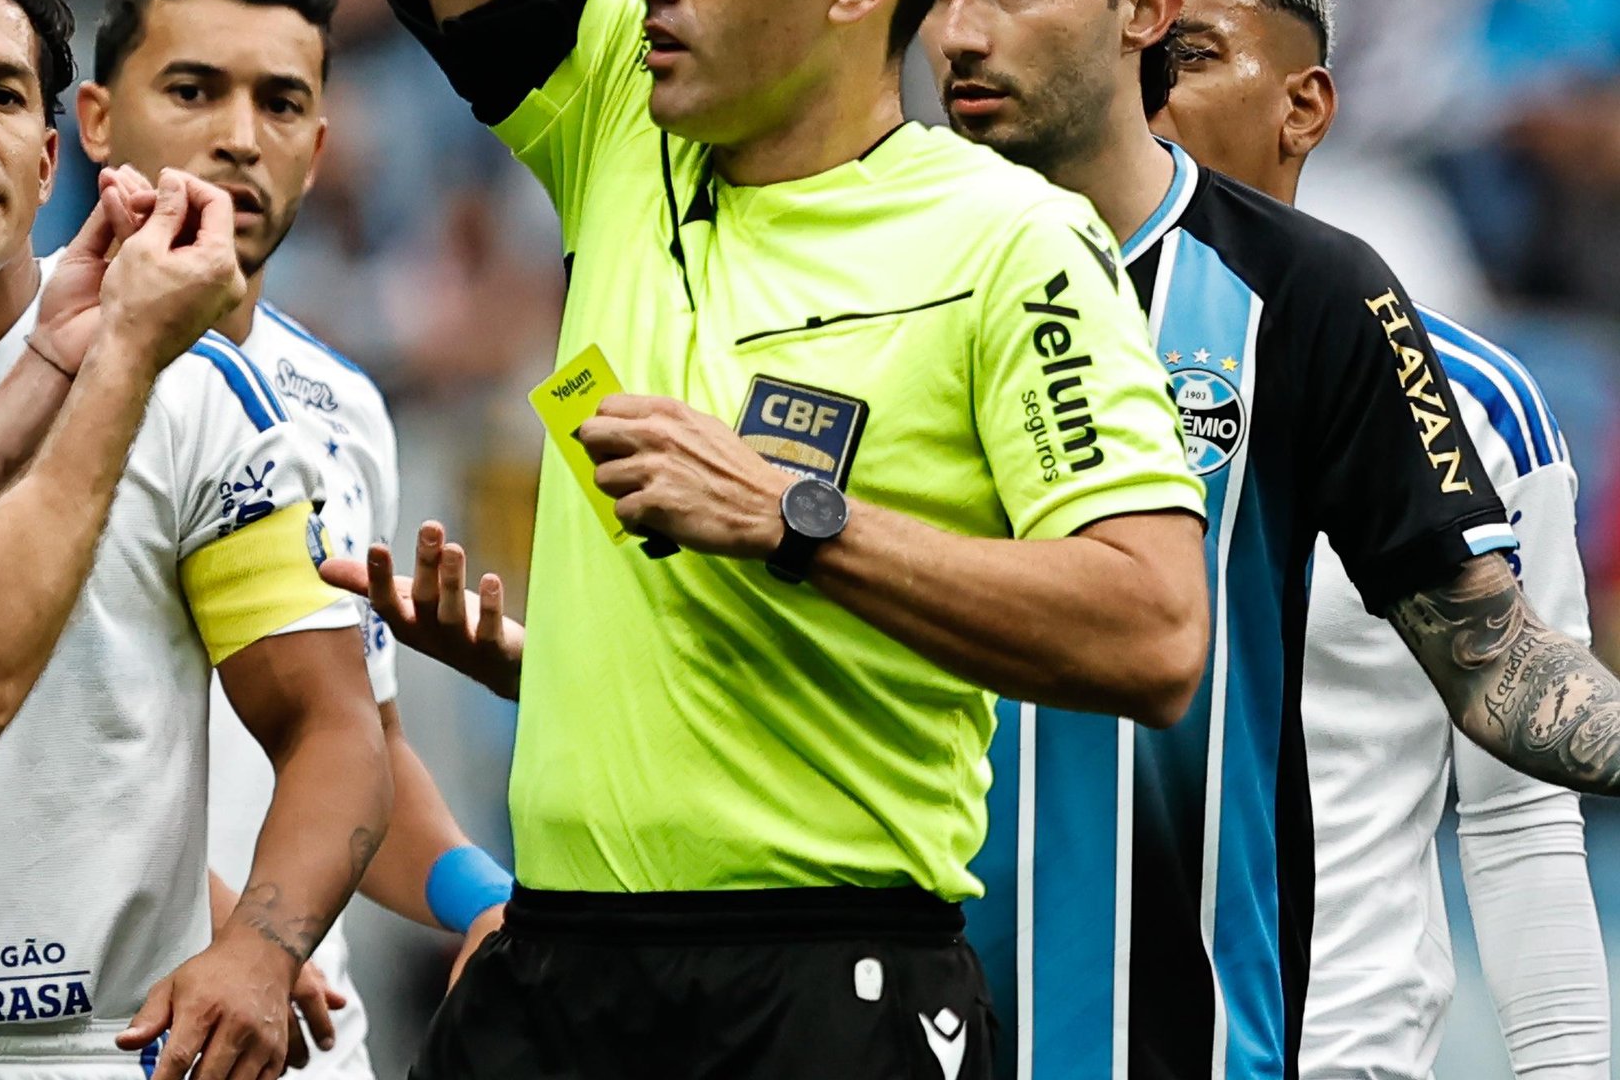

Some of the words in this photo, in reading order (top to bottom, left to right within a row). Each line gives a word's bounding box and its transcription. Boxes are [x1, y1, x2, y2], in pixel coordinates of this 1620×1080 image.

[551, 368, 592, 401] Yelum
[1023, 270, 1104, 473] Yelum
[1185, 390, 1207, 401] 1903
[1365, 287, 1473, 497] HAVAN
[760, 393, 840, 437] CBF
[1181, 409, 1237, 439] ÊMIO
[1021, 389, 1059, 484] seguros
[1187, 446, 1199, 454] PA
